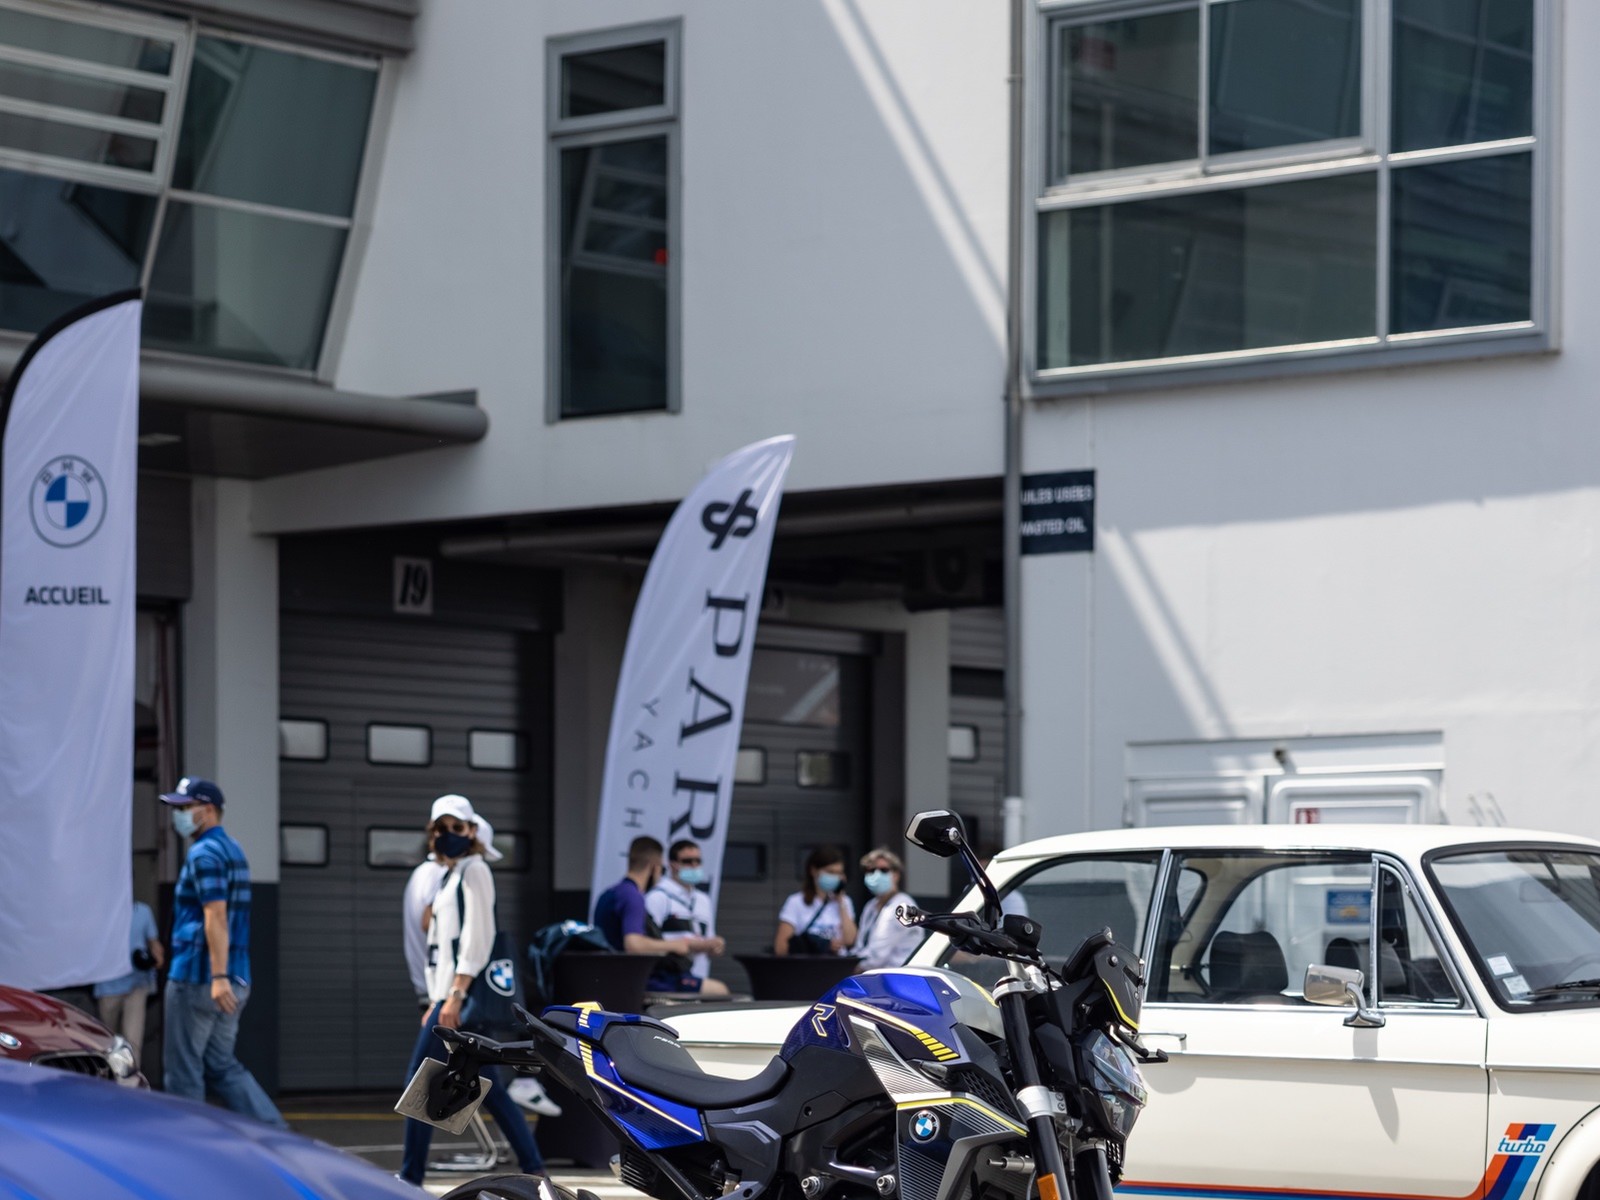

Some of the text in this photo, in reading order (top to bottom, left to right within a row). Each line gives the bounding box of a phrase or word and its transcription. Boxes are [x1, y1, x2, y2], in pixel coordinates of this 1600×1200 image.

[25, 586, 111, 605] ACCUEIL
[400, 564, 429, 607] 19
[619, 698, 660, 858] YACH
[811, 1003, 836, 1037] R
[1498, 1137, 1546, 1153] turbo
